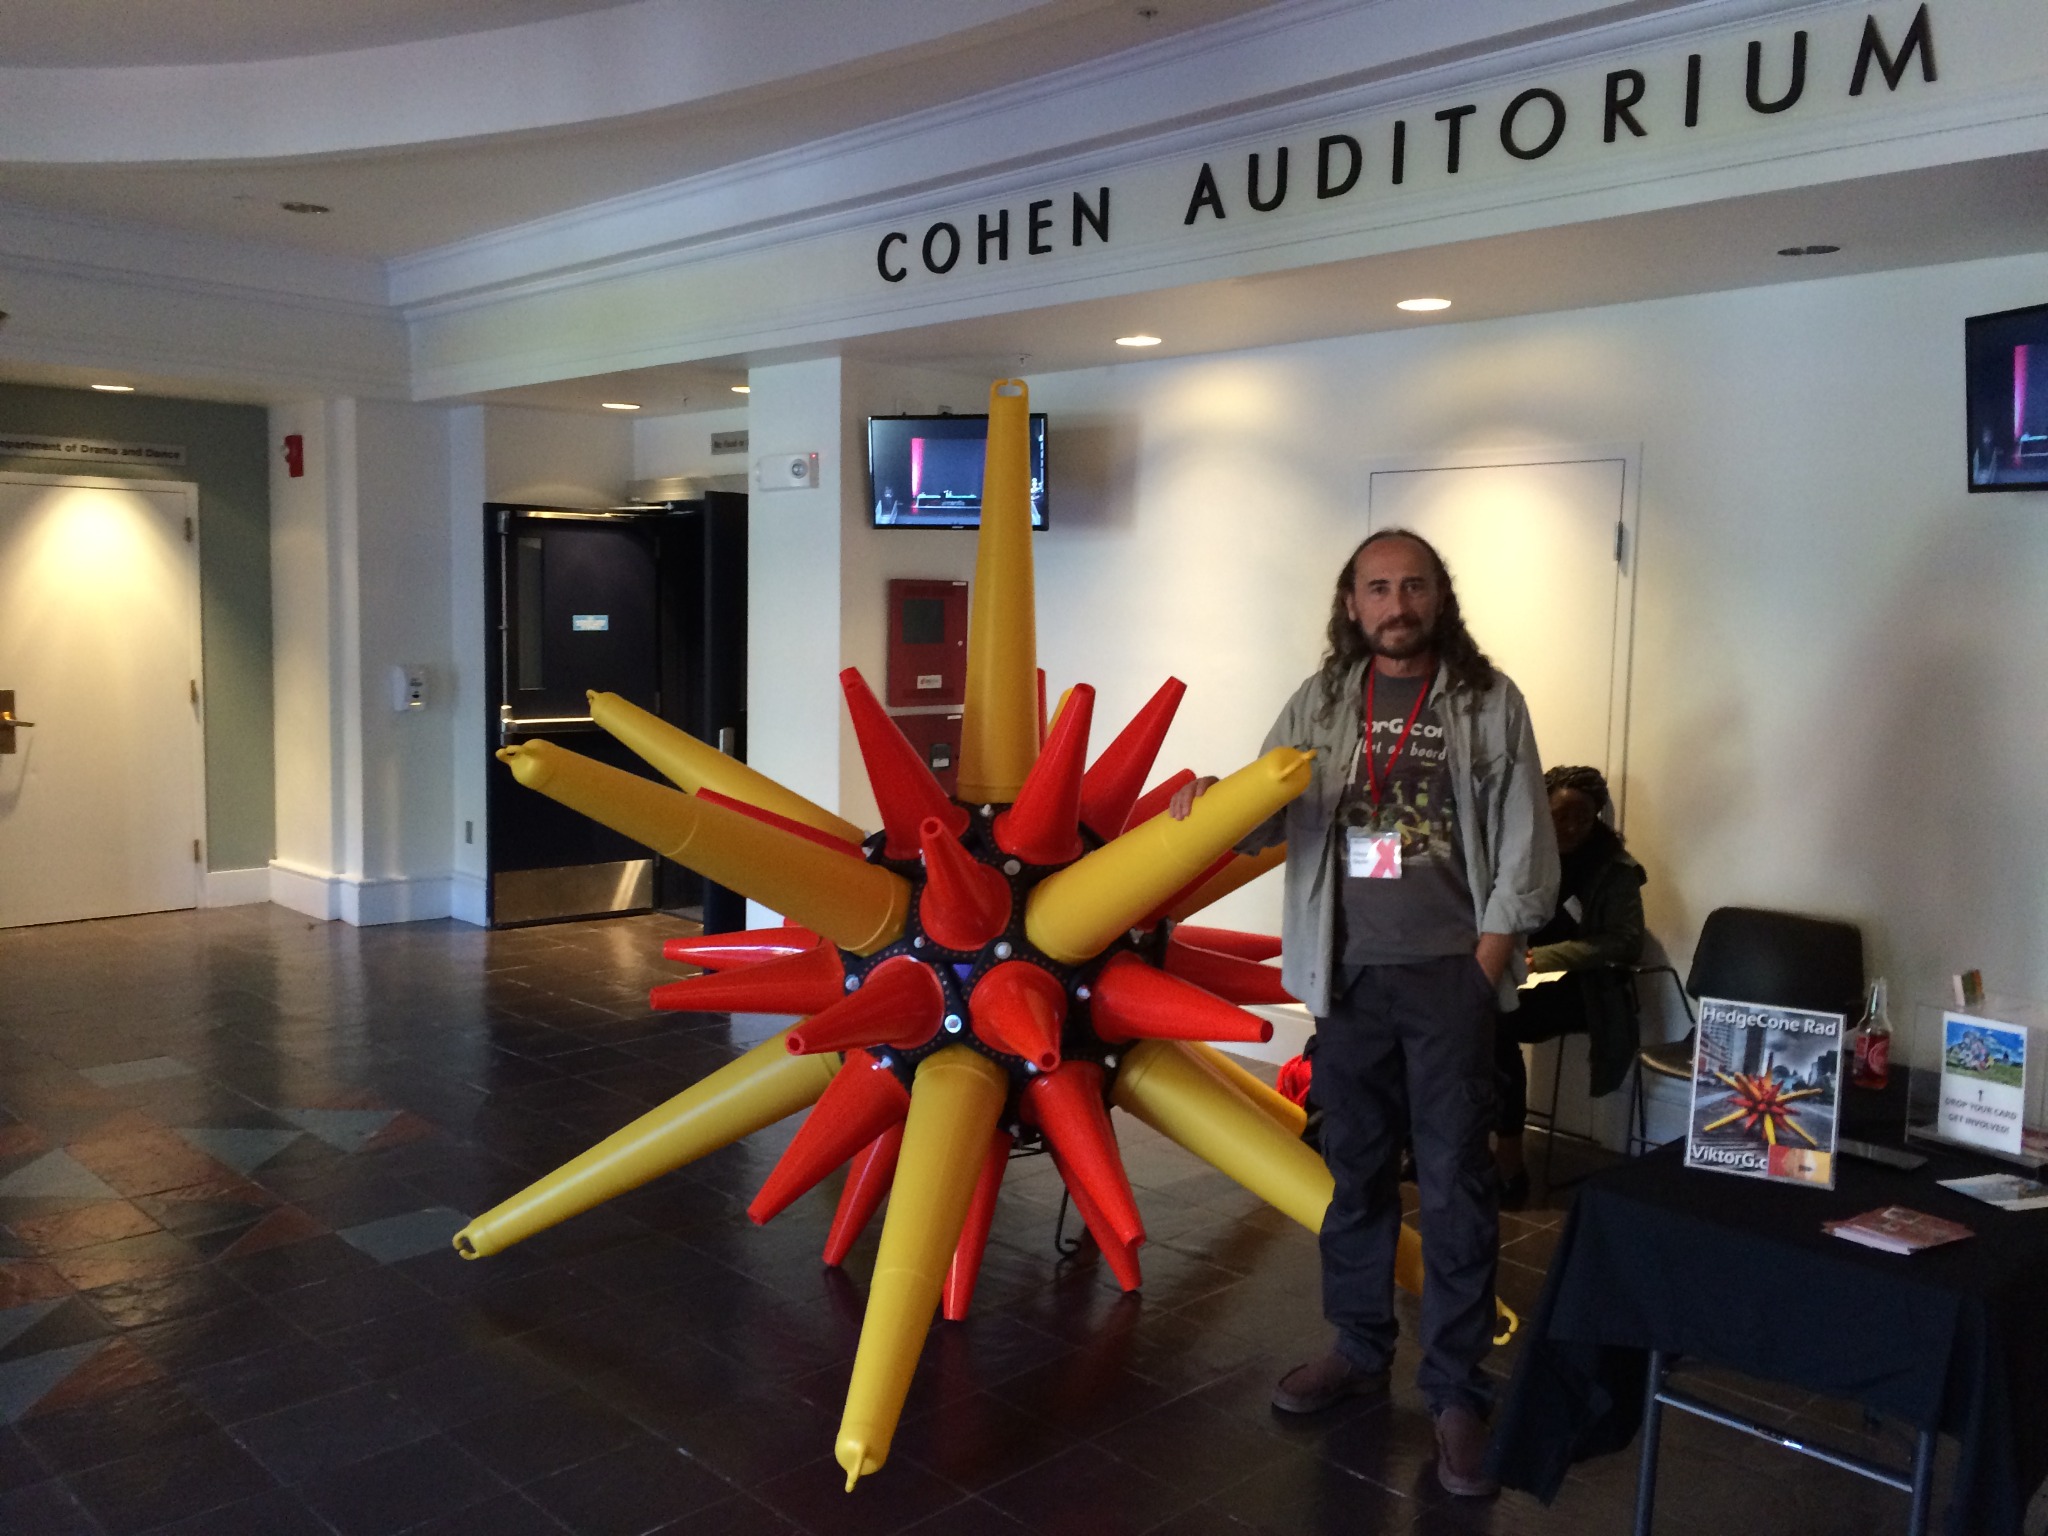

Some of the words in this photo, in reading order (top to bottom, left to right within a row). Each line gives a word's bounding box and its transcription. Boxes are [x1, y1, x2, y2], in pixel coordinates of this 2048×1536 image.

[877, 185, 1111, 283] COHEN
[1184, 3, 1938, 225] AUDITORIUM
[65, 444, 77, 452] of
[81, 444, 118, 455] Drama
[121, 448, 143, 457] and
[145, 448, 180, 459] Dance
[1703, 1006, 1800, 1033] HedgeCone
[1803, 1018, 1837, 1037] Rad
[1948, 1112, 1964, 1123] GET
[1970, 1102, 1993, 1115] YOUR
[1993, 1108, 2017, 1121] CARD
